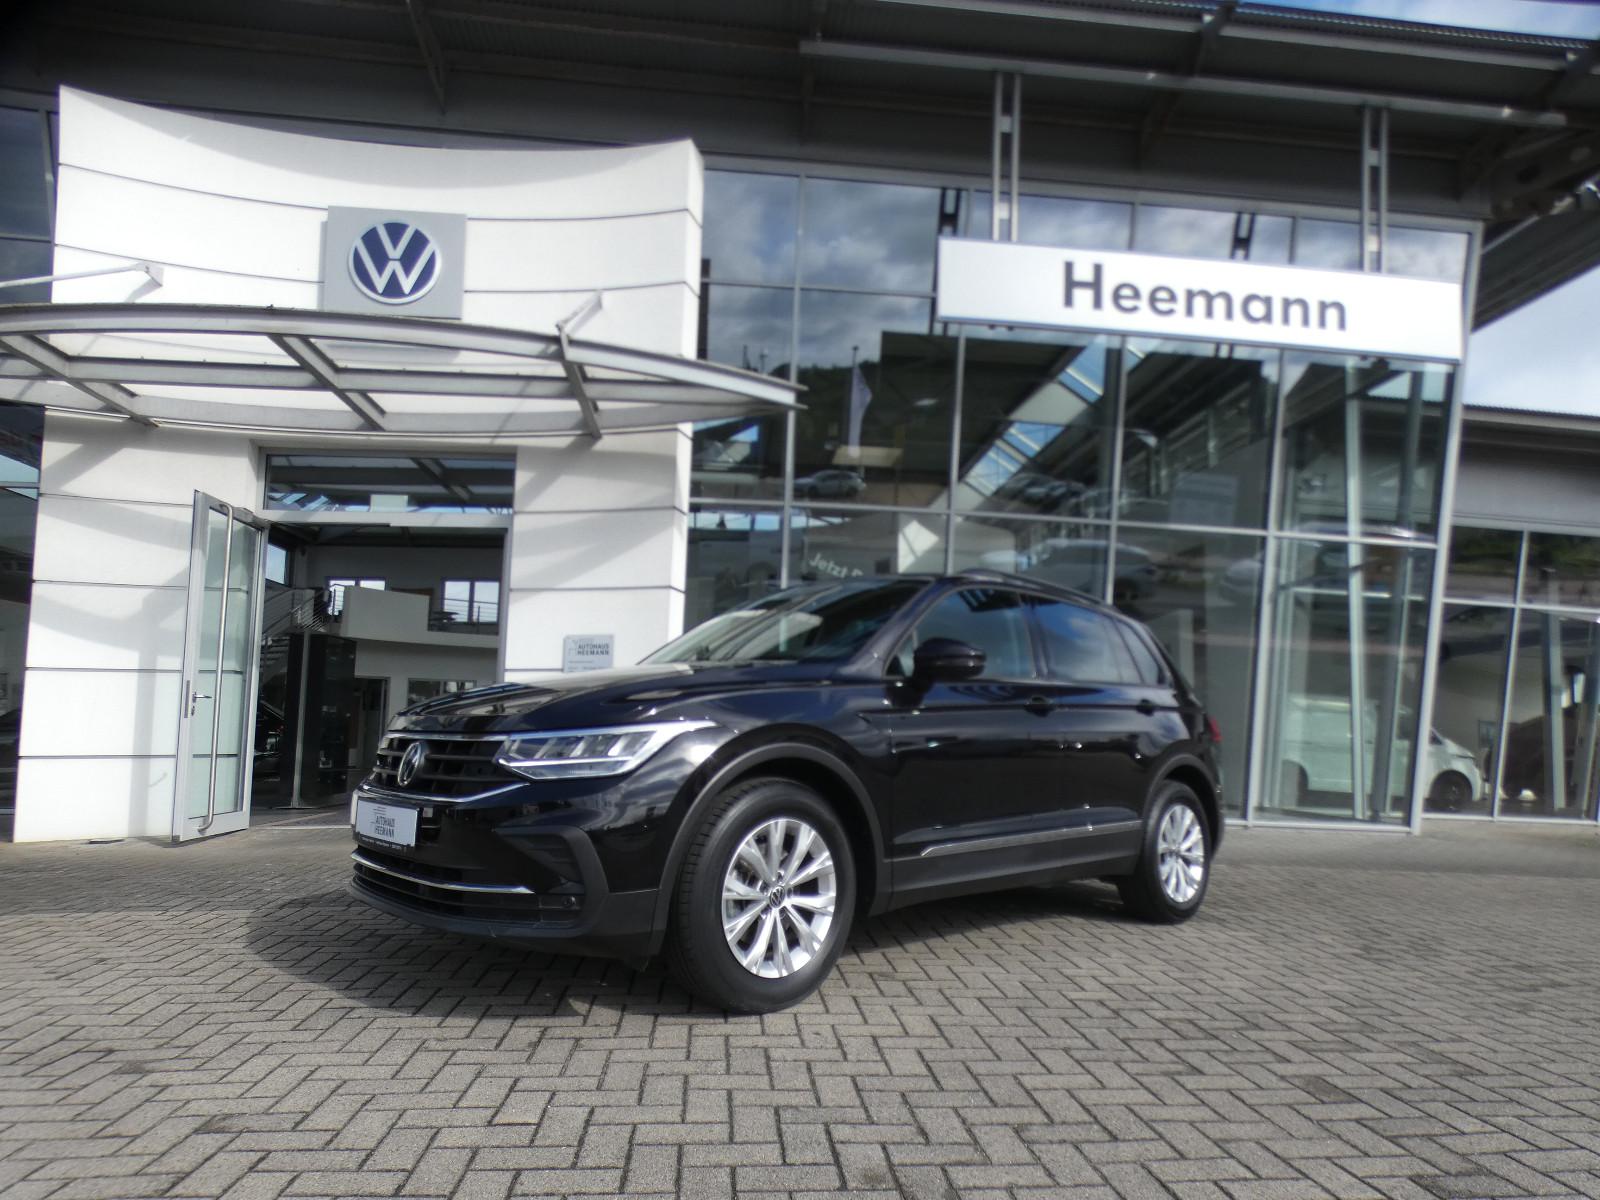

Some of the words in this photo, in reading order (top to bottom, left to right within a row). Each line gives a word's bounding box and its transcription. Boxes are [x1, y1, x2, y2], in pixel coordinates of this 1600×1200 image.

[351, 220, 439, 299] VW
[1063, 260, 1348, 332] Heemann
[808, 552, 849, 579] Jetzt
